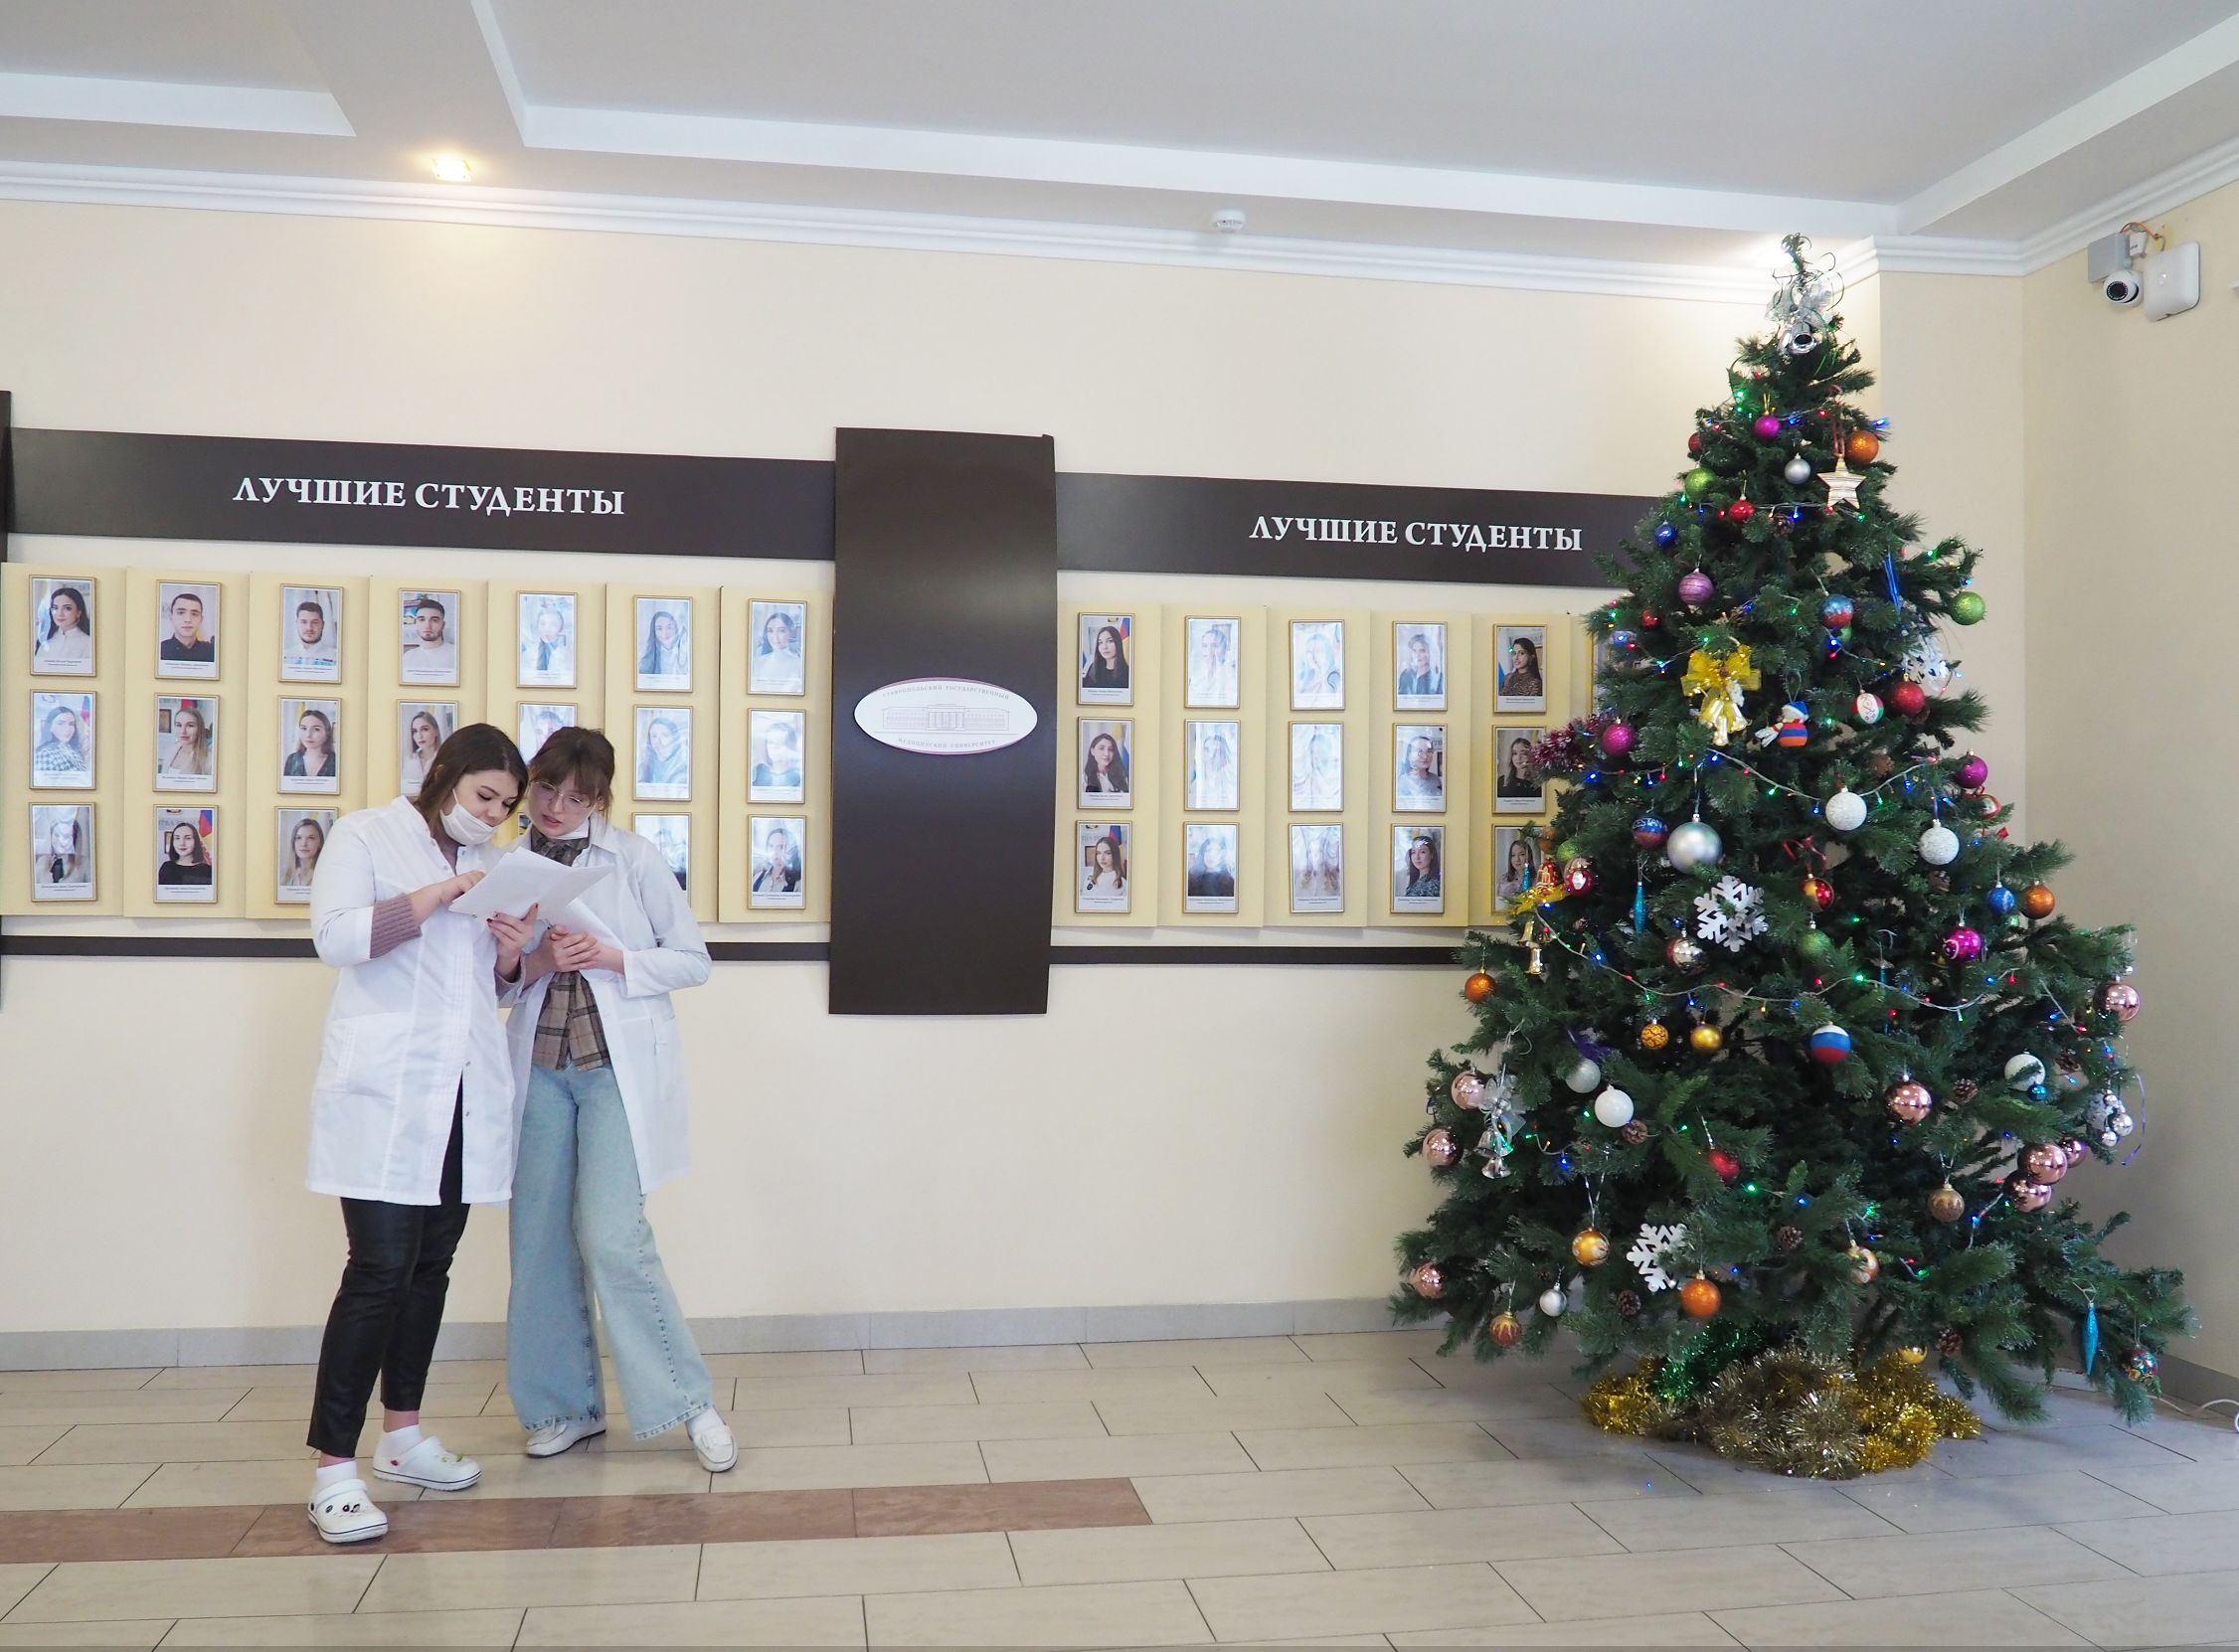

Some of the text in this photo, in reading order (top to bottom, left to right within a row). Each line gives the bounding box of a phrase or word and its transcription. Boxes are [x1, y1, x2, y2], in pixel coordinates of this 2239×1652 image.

[232, 477, 625, 518] ЛУЧШИЕ СТУДЕНТЫ
[1249, 516, 1583, 553] ЛУЧШИЕ СТУДЕНТЫ
